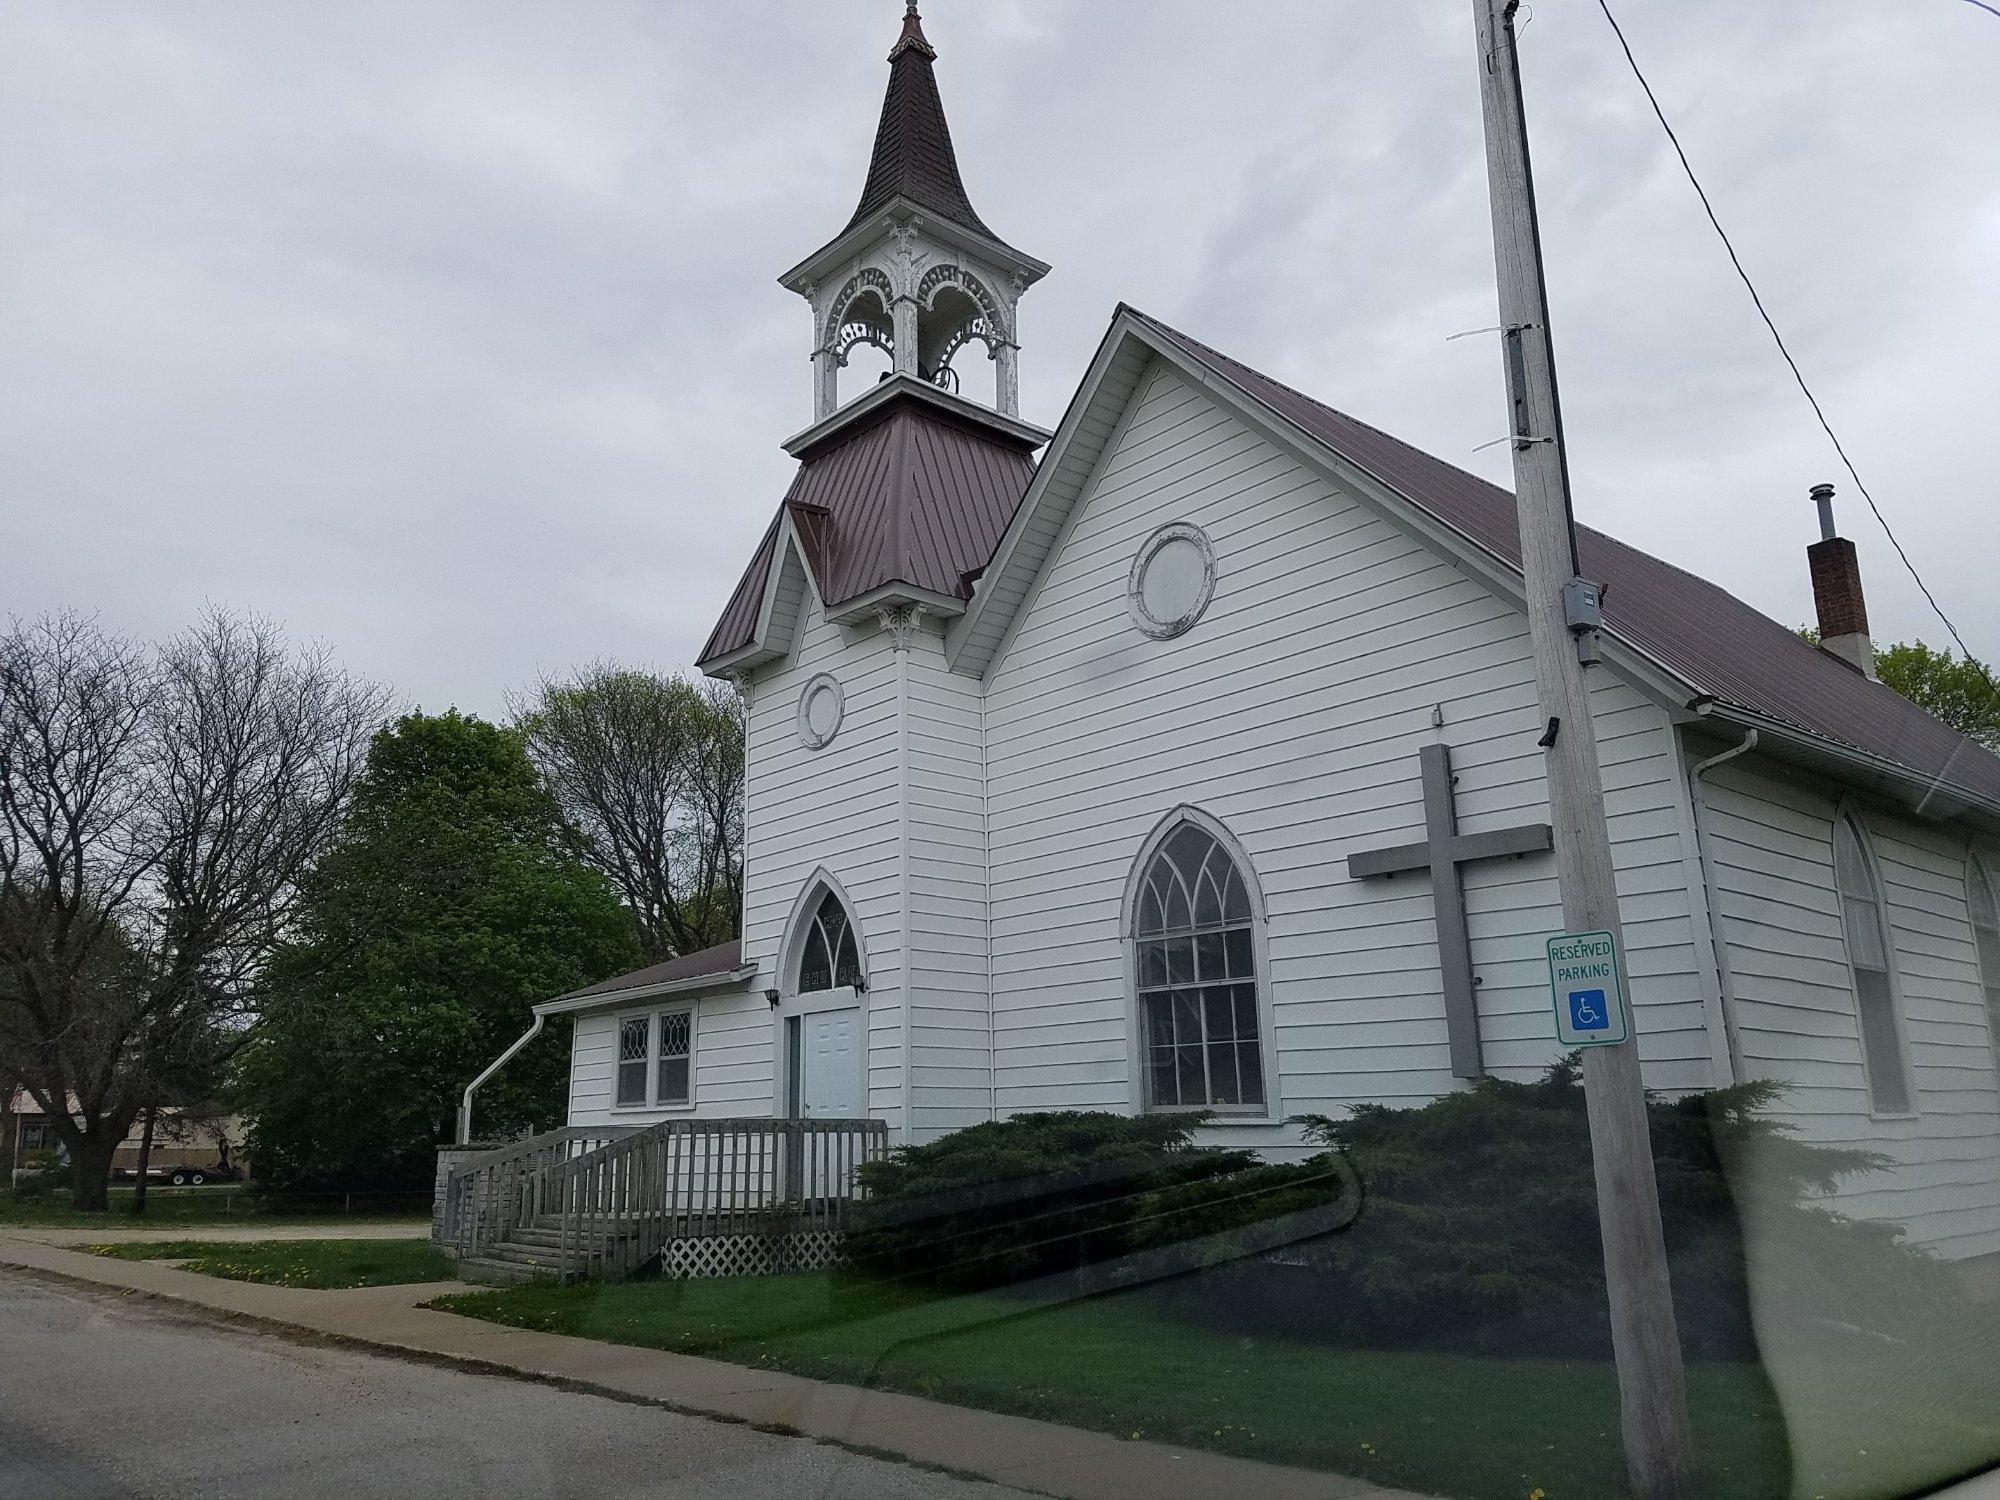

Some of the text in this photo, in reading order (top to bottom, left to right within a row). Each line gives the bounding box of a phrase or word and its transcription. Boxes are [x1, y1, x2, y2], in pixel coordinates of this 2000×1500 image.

[1551, 941, 1611, 961] RESERVED
[803, 965, 858, 986] CHURC
[1558, 963, 1609, 980] PARKING
